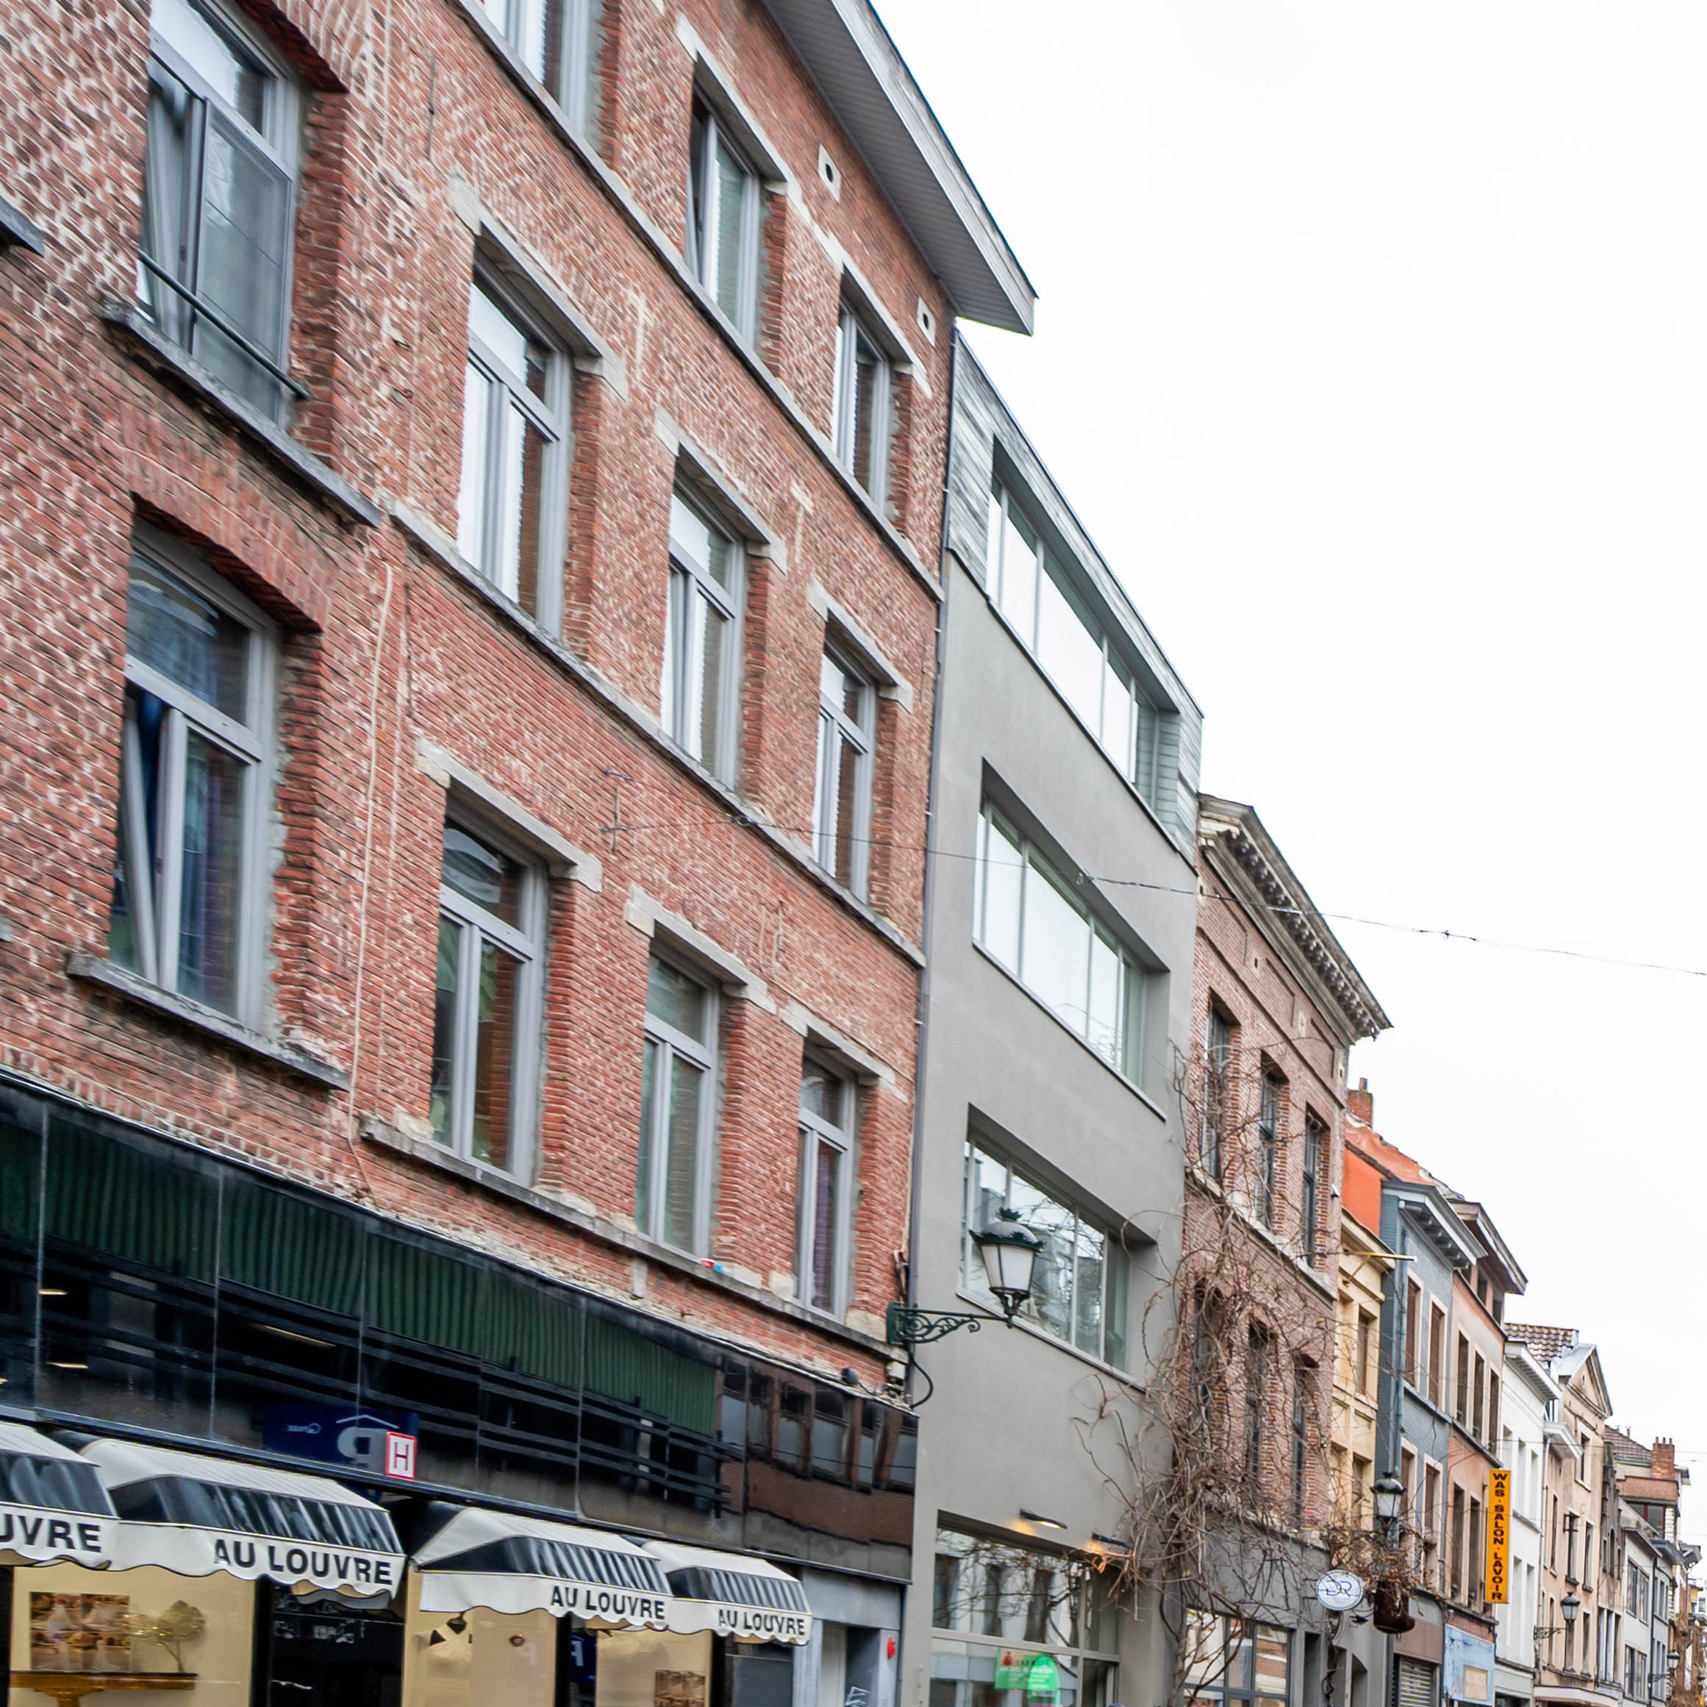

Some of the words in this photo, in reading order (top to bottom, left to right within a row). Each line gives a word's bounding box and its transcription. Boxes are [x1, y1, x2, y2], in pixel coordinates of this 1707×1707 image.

[393, 1441, 410, 1472] H
[1493, 1472, 1508, 1497] WAS
[1493, 1504, 1504, 1545] SALON
[213, 1538, 256, 1568] AU
[267, 1545, 394, 1586] LOUVRE
[1491, 1552, 1503, 1600] LAVOIR
[551, 1585, 578, 1608] AU
[585, 1590, 665, 1620] LOUVRE
[718, 1609, 738, 1629] AU
[743, 1612, 805, 1636] LOUVRE
